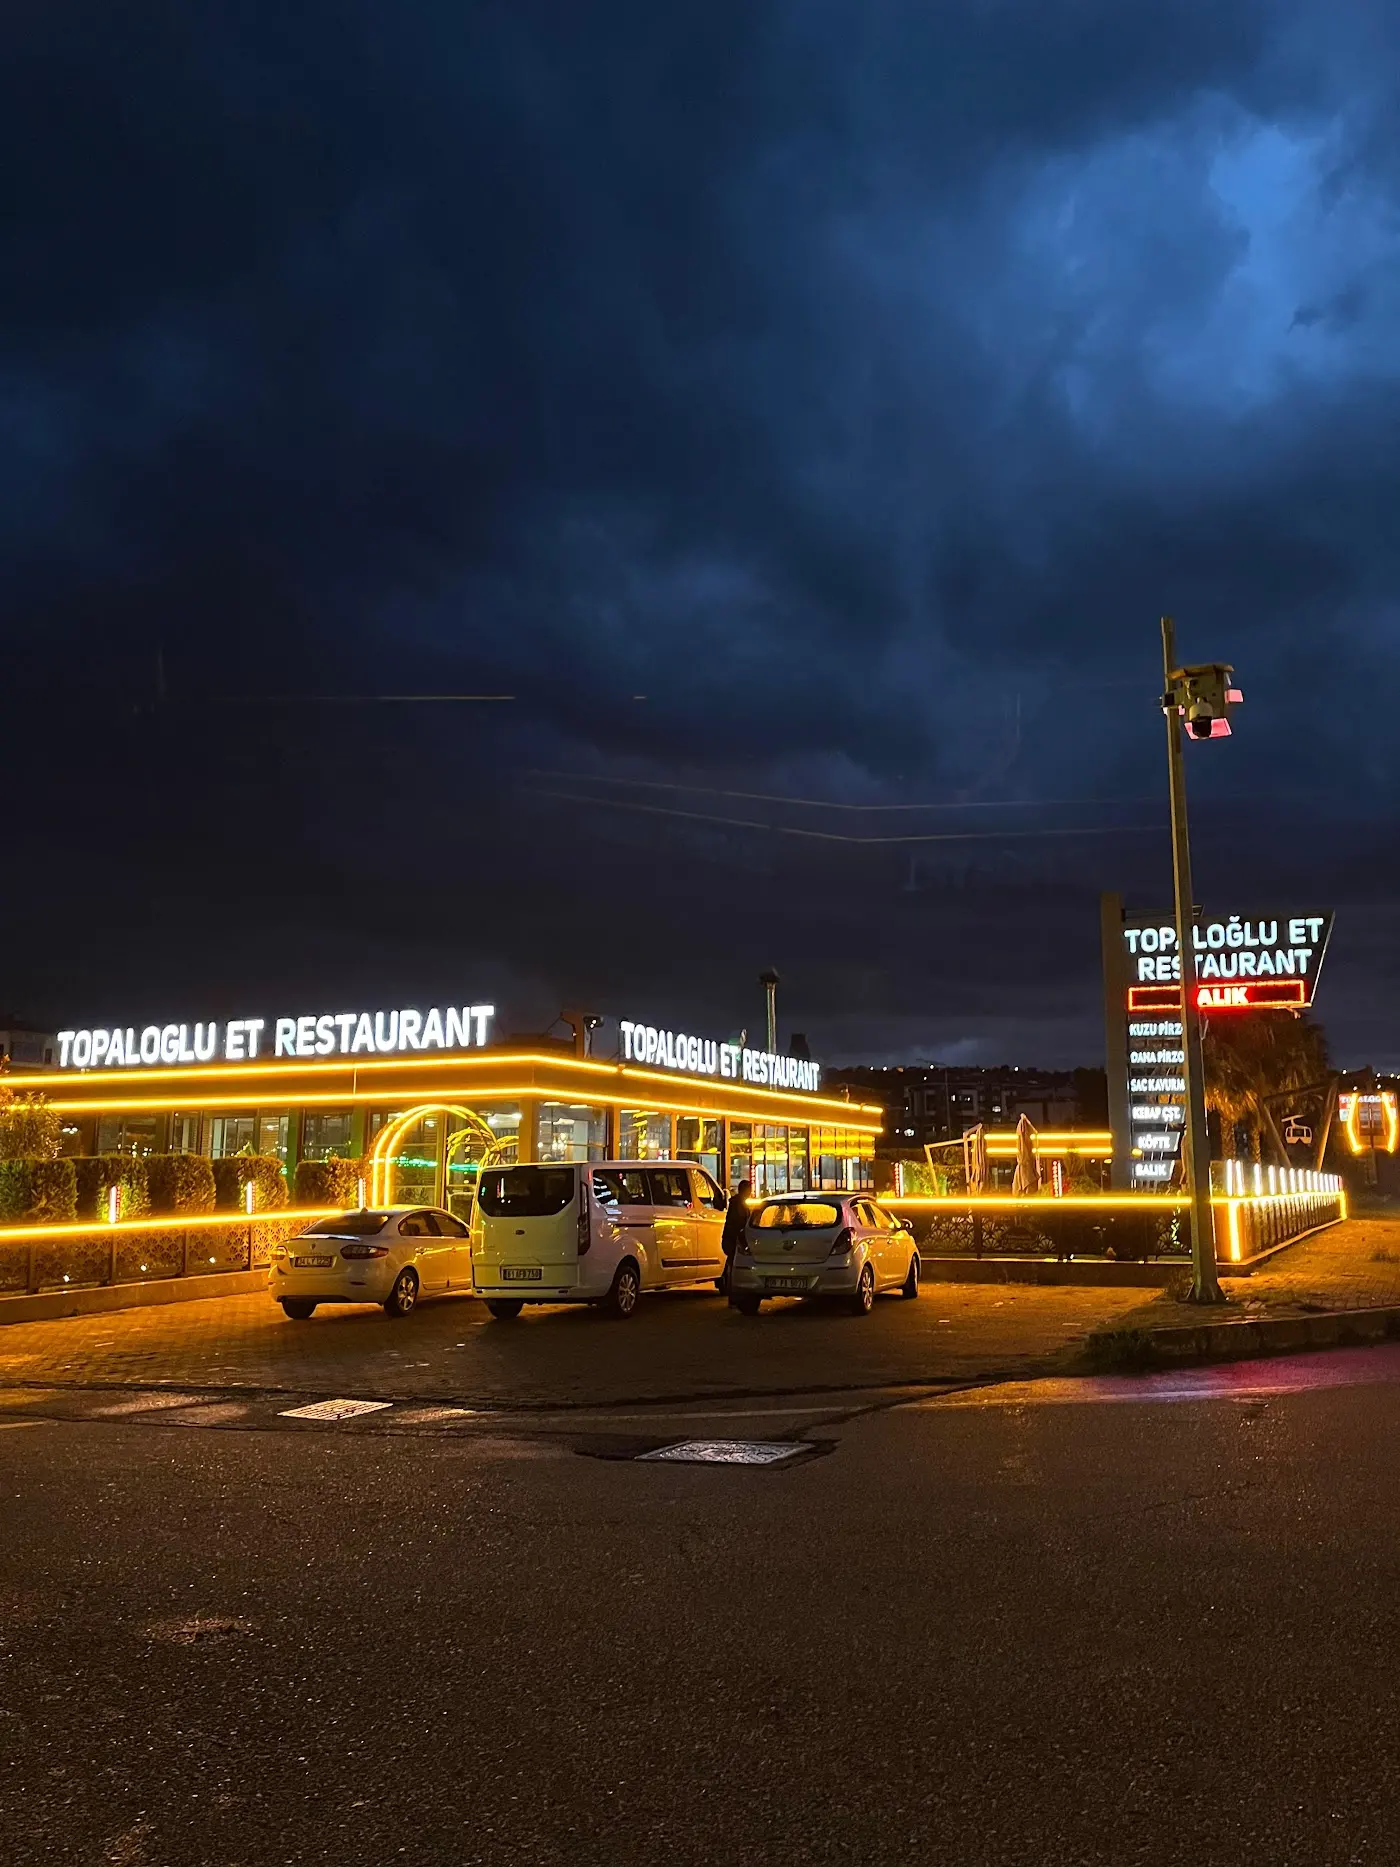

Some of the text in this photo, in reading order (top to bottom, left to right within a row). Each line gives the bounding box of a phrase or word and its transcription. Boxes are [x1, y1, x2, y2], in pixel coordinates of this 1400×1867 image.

[1124, 916, 1324, 953] TOPLOĞLU ET
[1197, 986, 1249, 1006] ALIK
[1129, 1020, 1183, 1036] KUZU PİRZ
[57, 1006, 495, 1067] TOPALOGLU ET RESTAURANT
[620, 1021, 820, 1091] TOPALOGLU ET RESTAURANT
[1130, 1048, 1184, 1063] DANA PİRZO
[1130, 1077, 1185, 1092] SAC KAVURM
[1132, 1106, 1161, 1119] KEBAP
[1138, 1133, 1170, 1149] KÖFTE
[1135, 1163, 1166, 1176] BALIK
